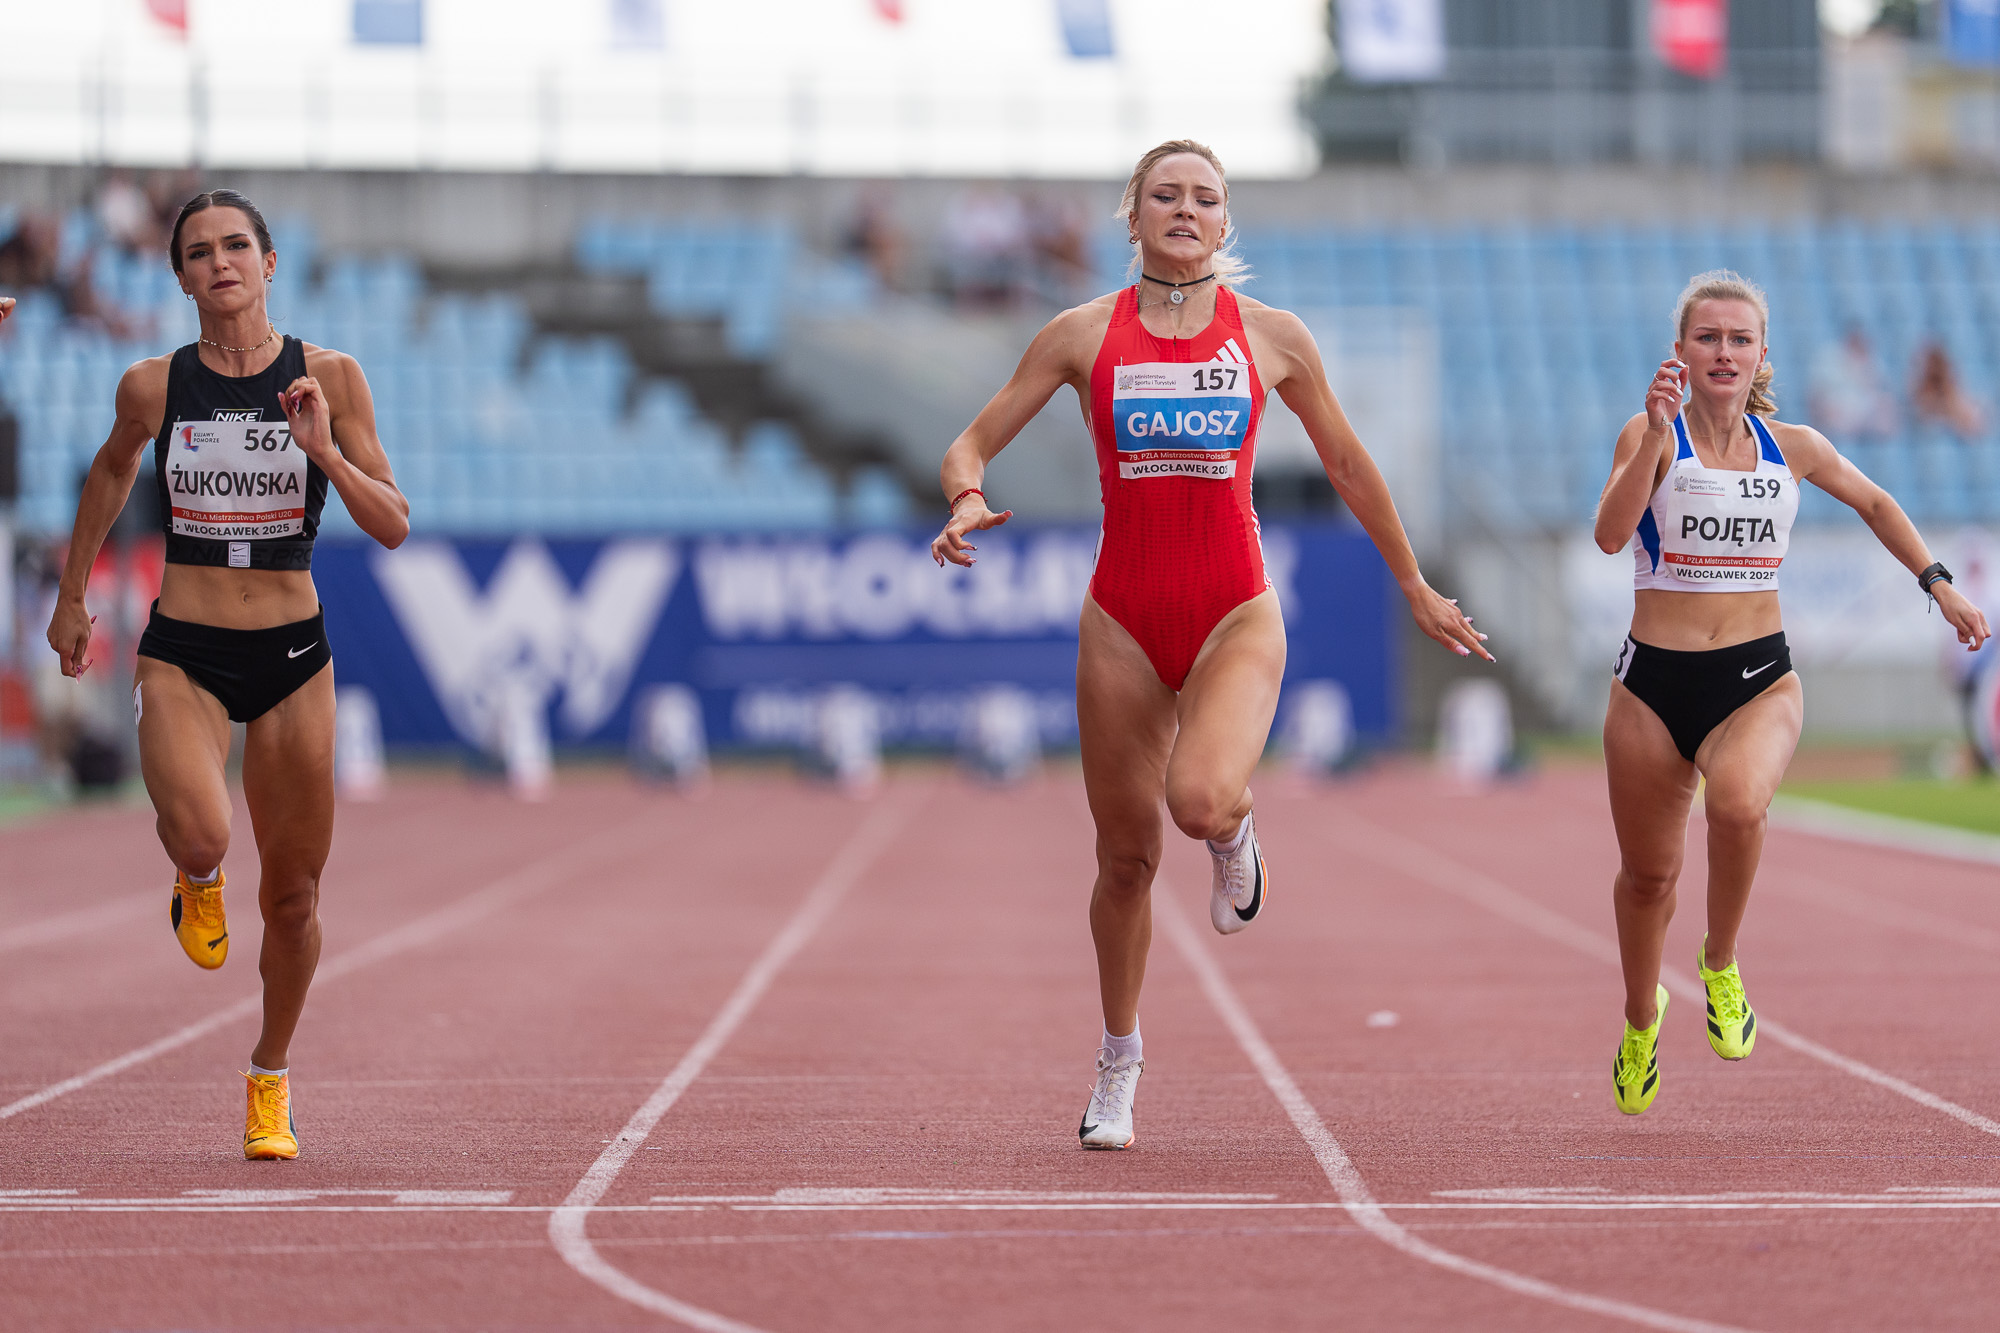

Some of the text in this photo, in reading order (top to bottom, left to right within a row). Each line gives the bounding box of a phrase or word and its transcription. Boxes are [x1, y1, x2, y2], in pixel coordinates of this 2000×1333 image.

[1192, 368, 1238, 391] 157
[215, 412, 258, 421] NIKE
[1127, 410, 1240, 438] GAJOSZ
[244, 429, 292, 452] 567
[1132, 464, 1209, 475] WŁOCŁAWEK
[171, 463, 300, 497] ŻUKOWSKA
[1738, 478, 1781, 499] 159
[182, 510, 192, 518] 79.
[192, 513, 208, 521] PZLA
[256, 512, 277, 520] Polski
[184, 523, 290, 536] WŁOCŁAWEK 2025
[1681, 515, 1776, 547] POJĘTA
[1704, 558, 1743, 566] Mistrzostwa
[1676, 568, 1747, 580] WŁOCŁAWEK
